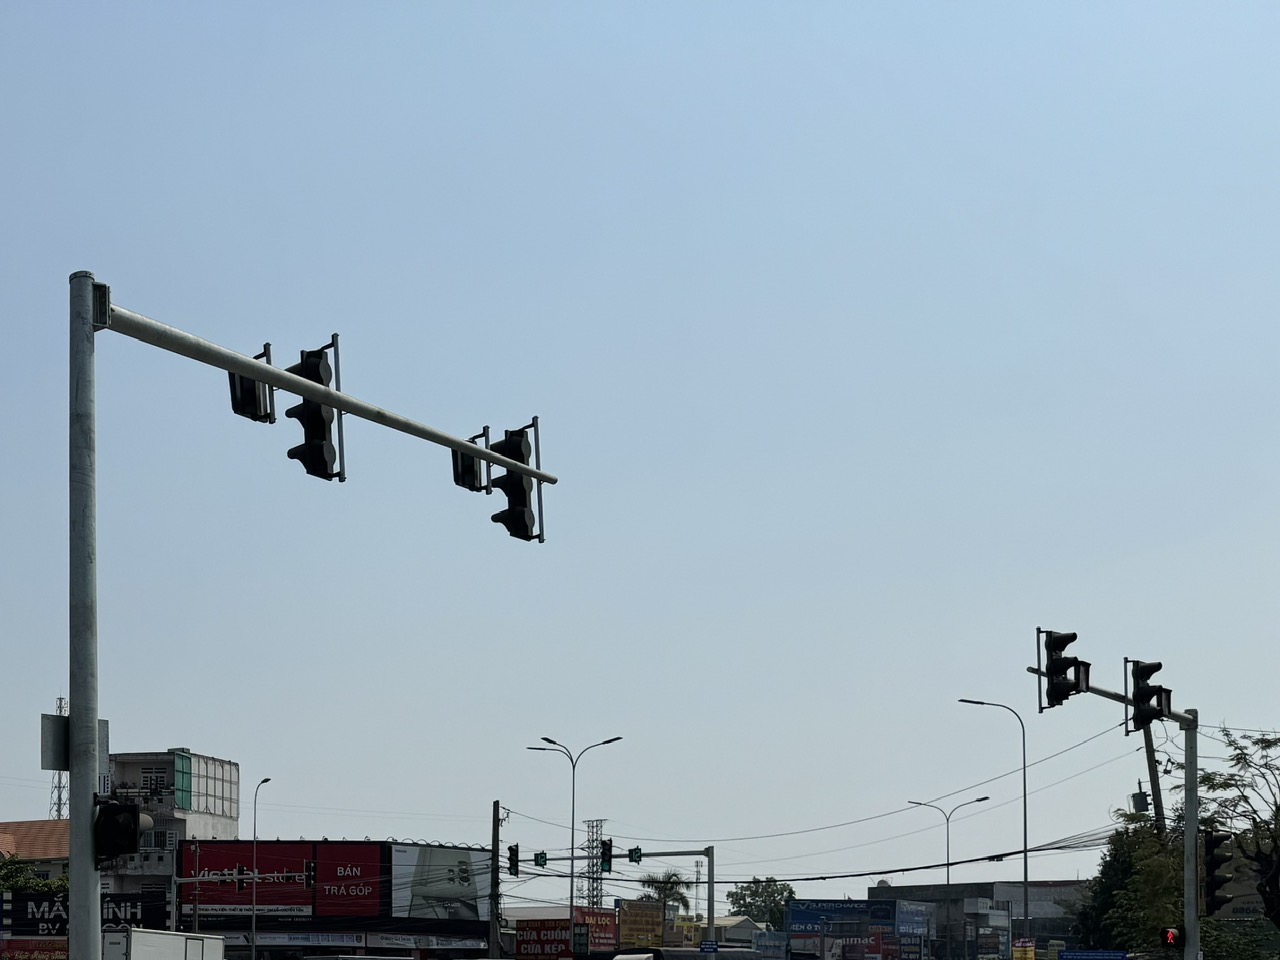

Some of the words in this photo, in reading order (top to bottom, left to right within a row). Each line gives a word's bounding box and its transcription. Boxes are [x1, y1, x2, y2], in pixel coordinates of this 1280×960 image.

[337, 864, 361, 876] BÁN
[264, 871, 306, 883] stoe
[349, 884, 372, 896] GÓP
[27, 893, 69, 919] MẮ
[102, 897, 142, 919] ÍNH
[517, 927, 538, 941] CỬA
[521, 941, 542, 954] CỬA
